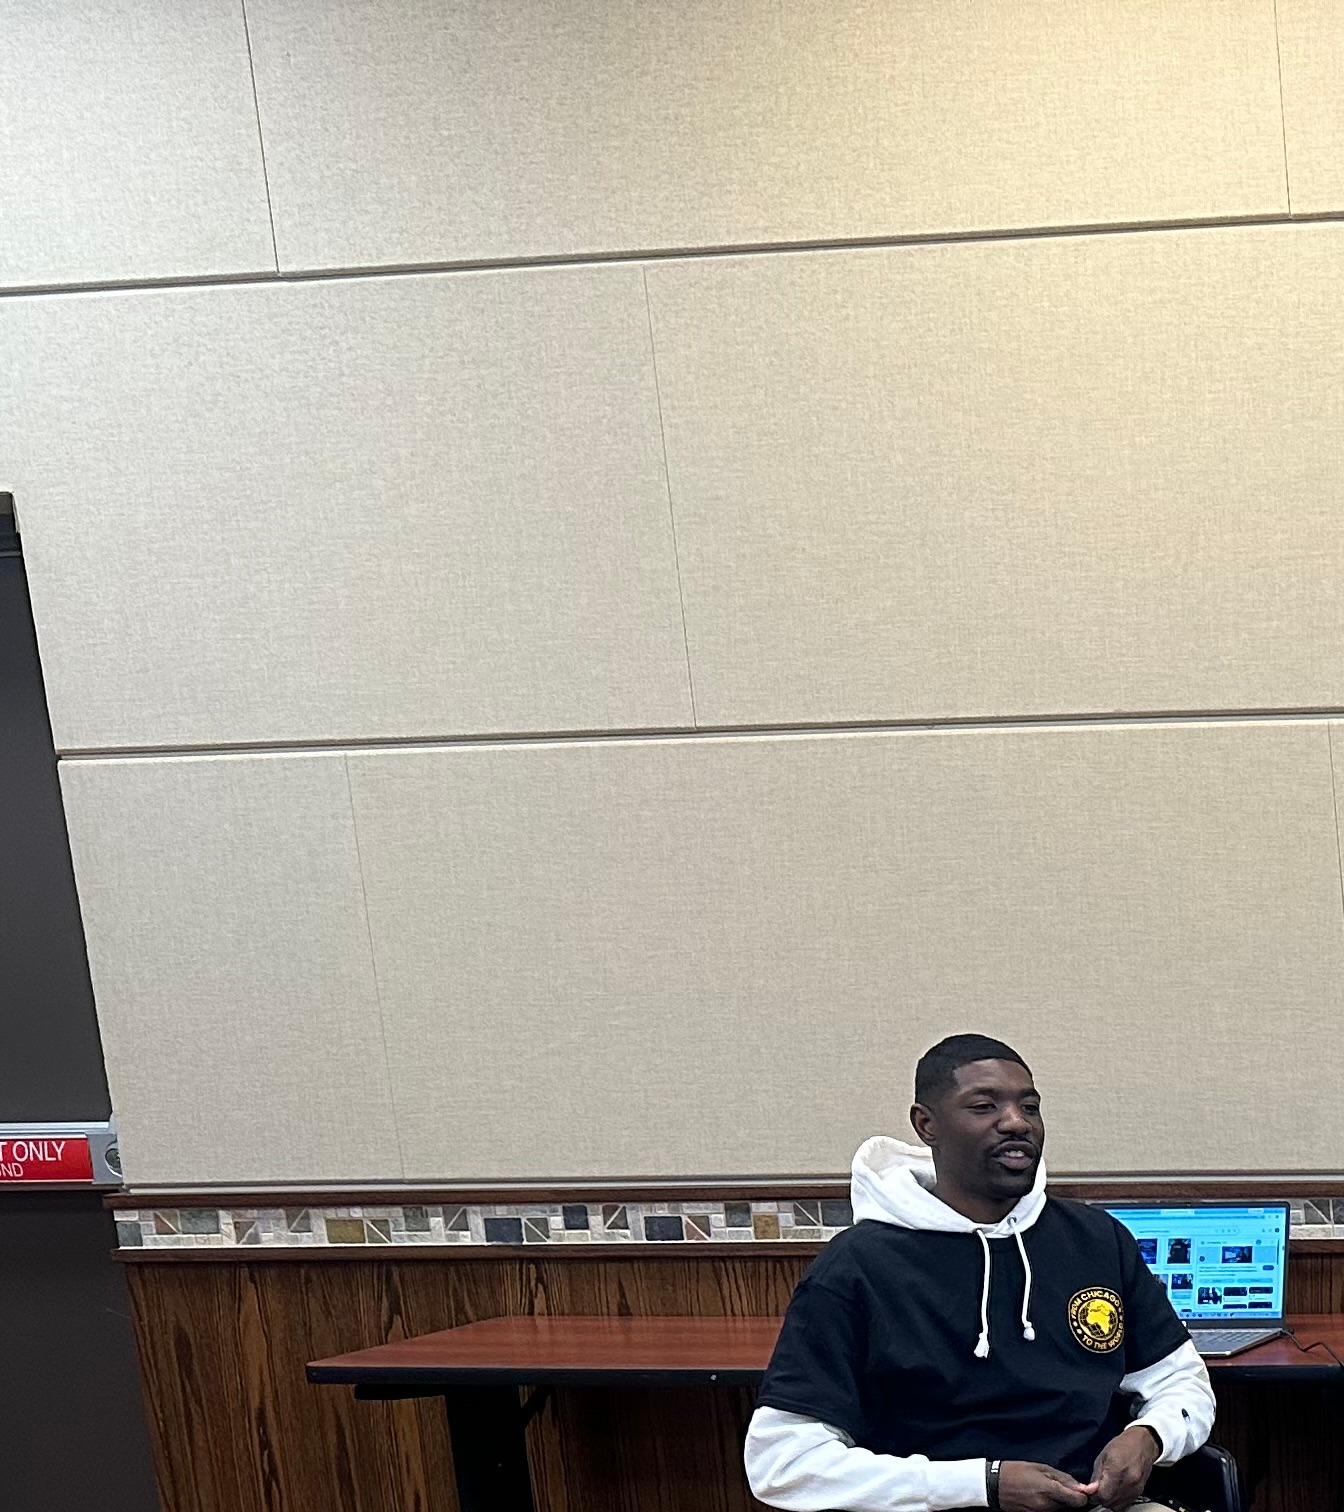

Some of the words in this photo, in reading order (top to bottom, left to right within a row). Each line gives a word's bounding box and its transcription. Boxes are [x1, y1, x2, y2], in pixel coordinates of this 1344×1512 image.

[13, 1141, 66, 1162] ONLY
[0, 1163, 24, 1177] ND
[1081, 1291, 1120, 1306] CHICAGO
[1082, 1335, 1093, 1345] TO
